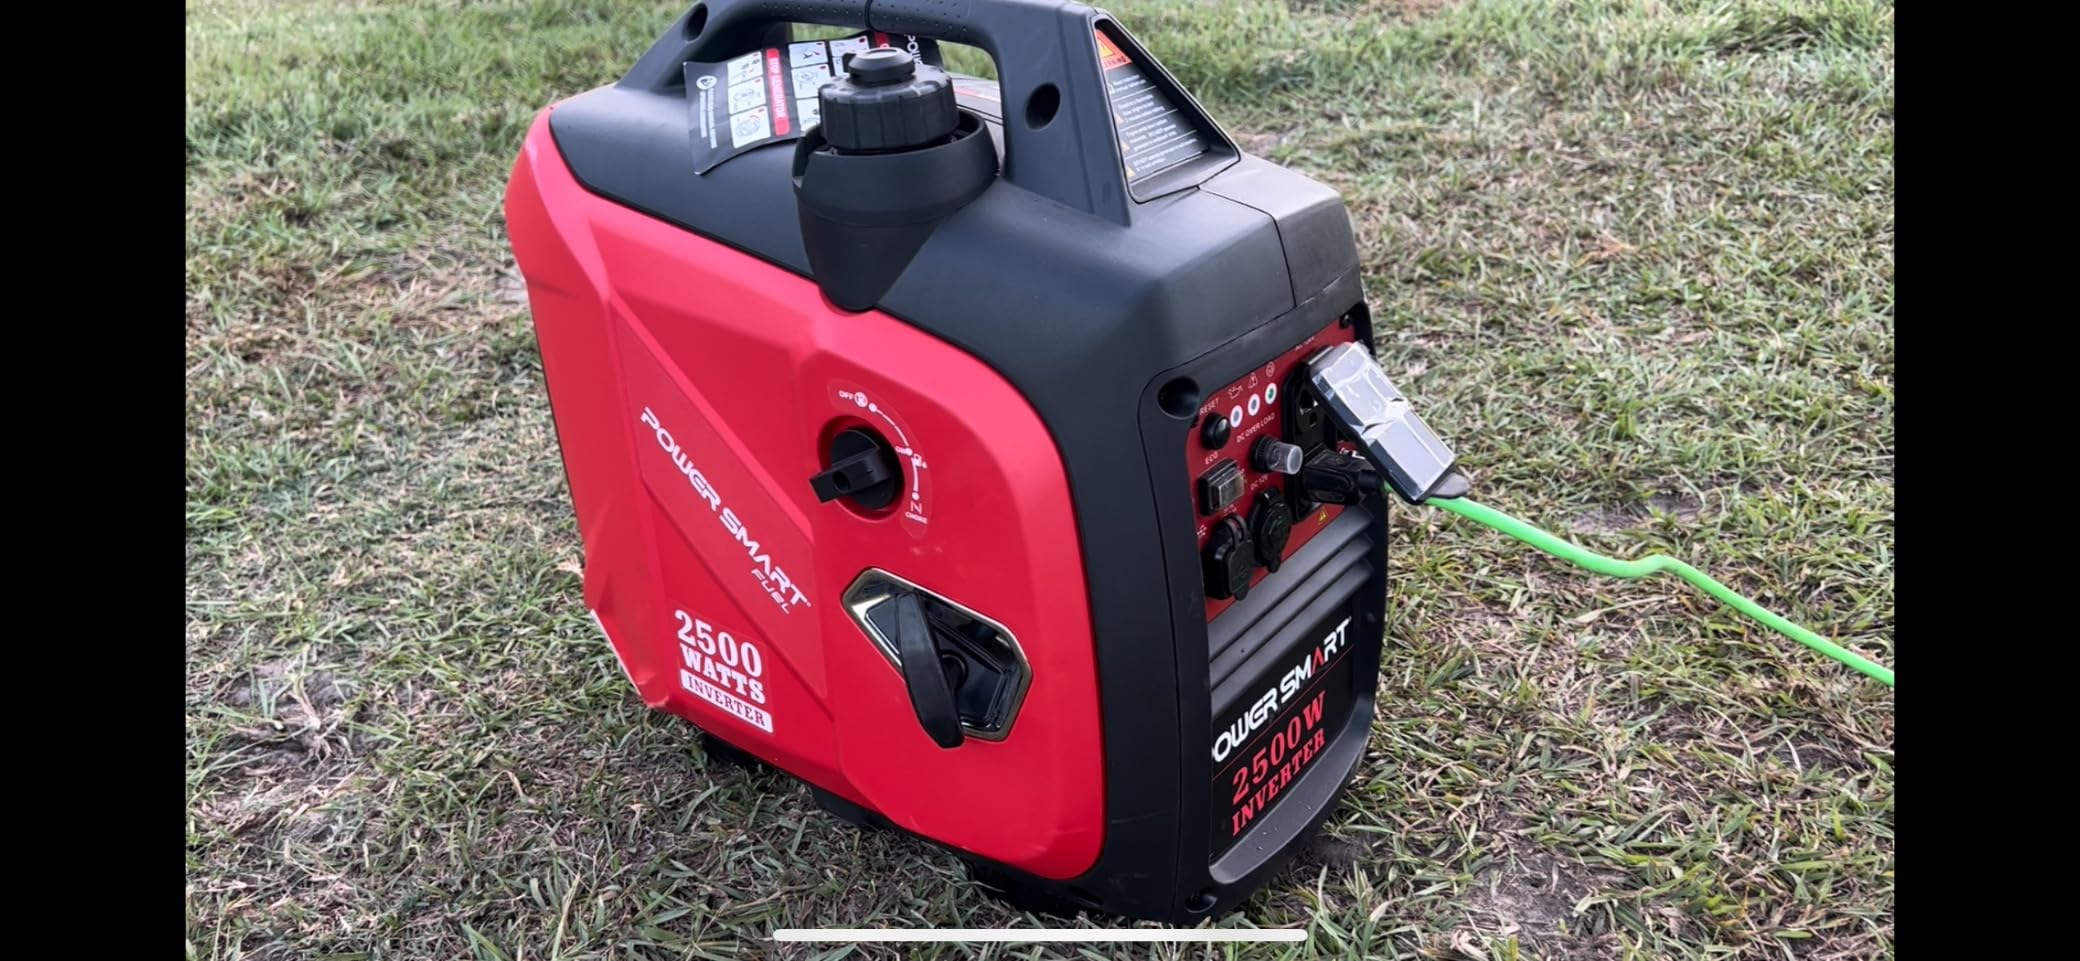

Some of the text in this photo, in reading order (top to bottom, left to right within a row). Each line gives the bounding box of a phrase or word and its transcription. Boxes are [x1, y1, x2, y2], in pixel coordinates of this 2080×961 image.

[838, 390, 854, 400] OFF
[1200, 398, 1220, 415] RESET
[1204, 452, 1219, 465] ECO
[640, 407, 808, 606] POWER SMART
[905, 511, 928, 524] CHOKE
[751, 568, 790, 614] FUEL
[675, 609, 762, 677] 2500
[680, 642, 766, 704] WATTS
[688, 676, 766, 726] INVERTER
[1212, 616, 1352, 762] OWER SMART
[1232, 690, 1326, 805] 2500W
[1232, 728, 1326, 836] INVERTER
